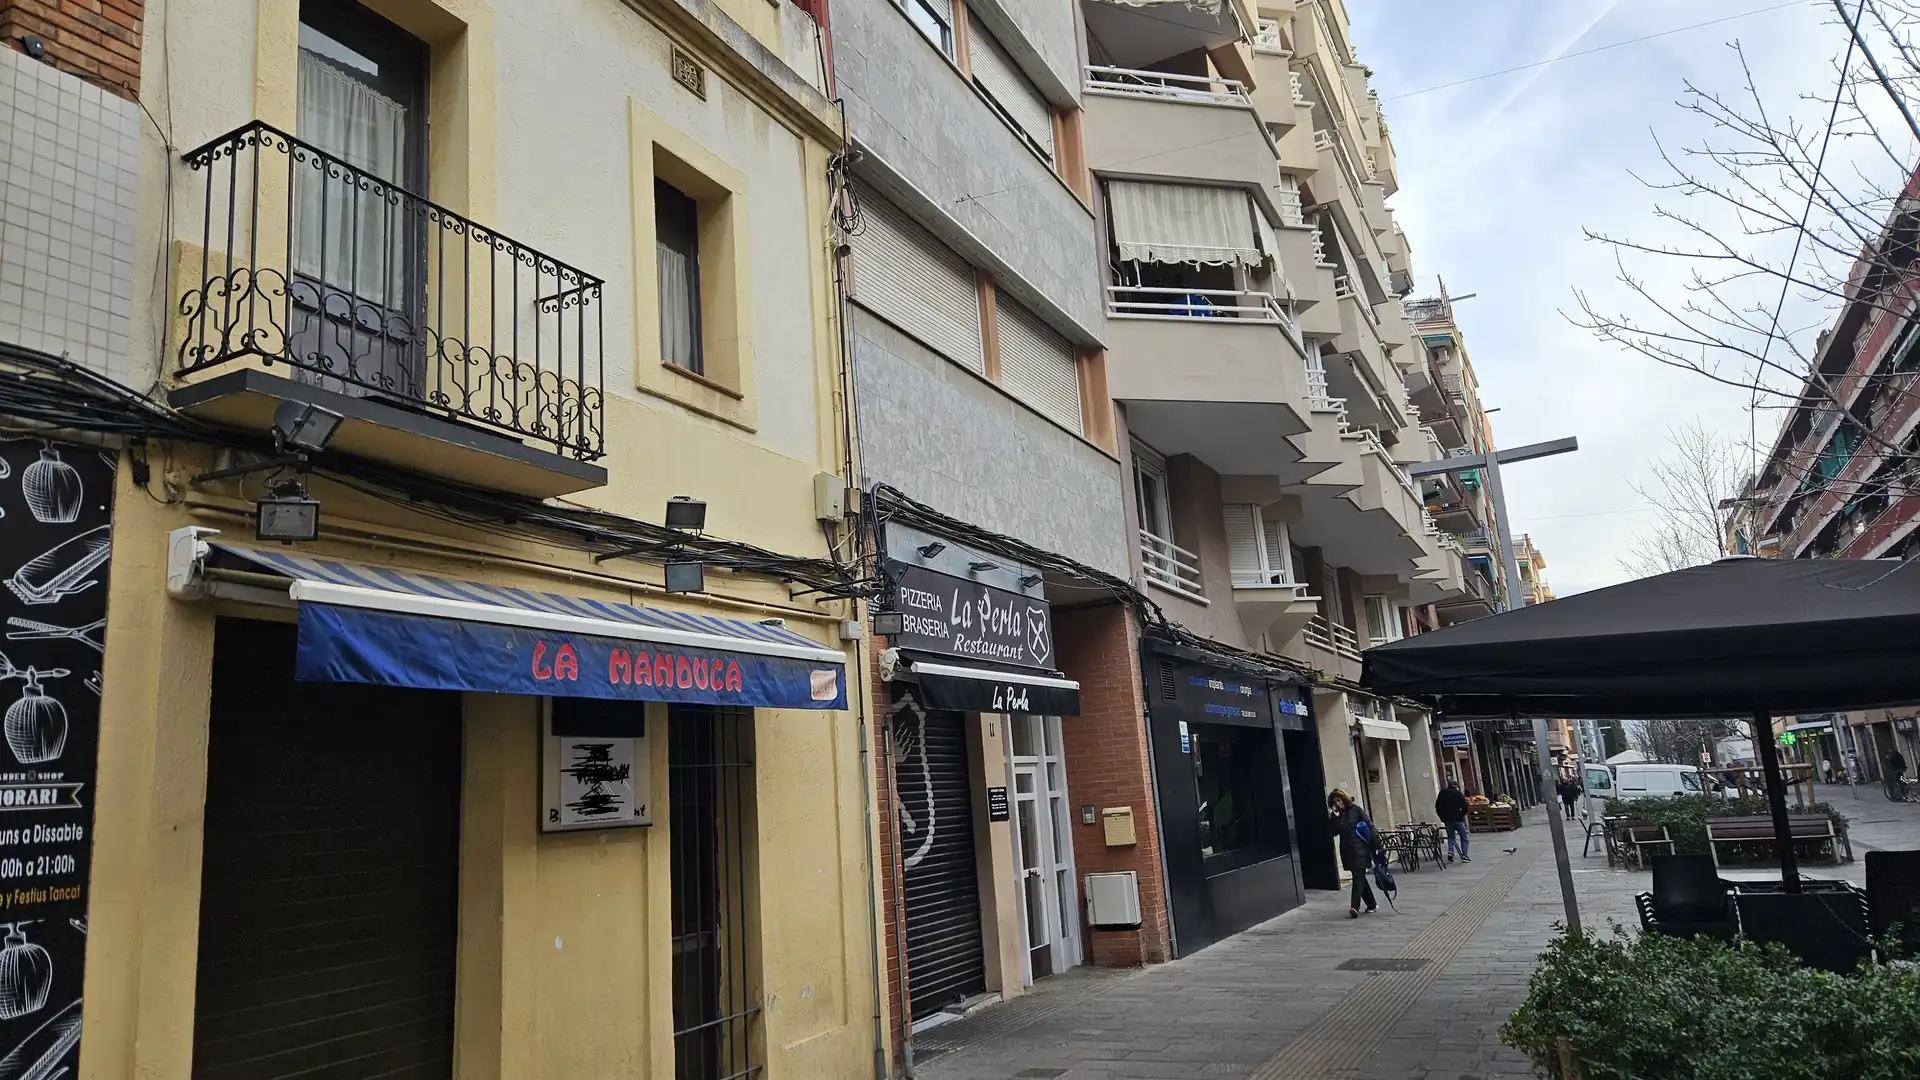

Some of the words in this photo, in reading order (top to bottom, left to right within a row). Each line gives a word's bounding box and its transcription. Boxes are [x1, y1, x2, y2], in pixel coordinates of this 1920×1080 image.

[901, 586, 943, 613] PIZZERIA
[951, 588, 972, 629] La
[977, 587, 1023, 638] Perla
[903, 614, 950, 639] BRASERIA
[954, 633, 1024, 661] Restaurant
[532, 640, 578, 681] LA
[609, 647, 743, 693] MANDUCA
[992, 686, 1003, 710] La
[1007, 686, 1030, 712] Perla
[0, 773, 26, 781] RBER
[38, 772, 64, 780] SHOP
[0, 789, 58, 806] ORARI
[22, 828, 31, 844] a
[34, 822, 84, 843] Dissabte
[26, 860, 34, 877] a
[37, 854, 75, 876] 21:00h
[6, 892, 12, 910] y
[14, 887, 47, 906] Festius
[49, 884, 81, 902] Tancat
